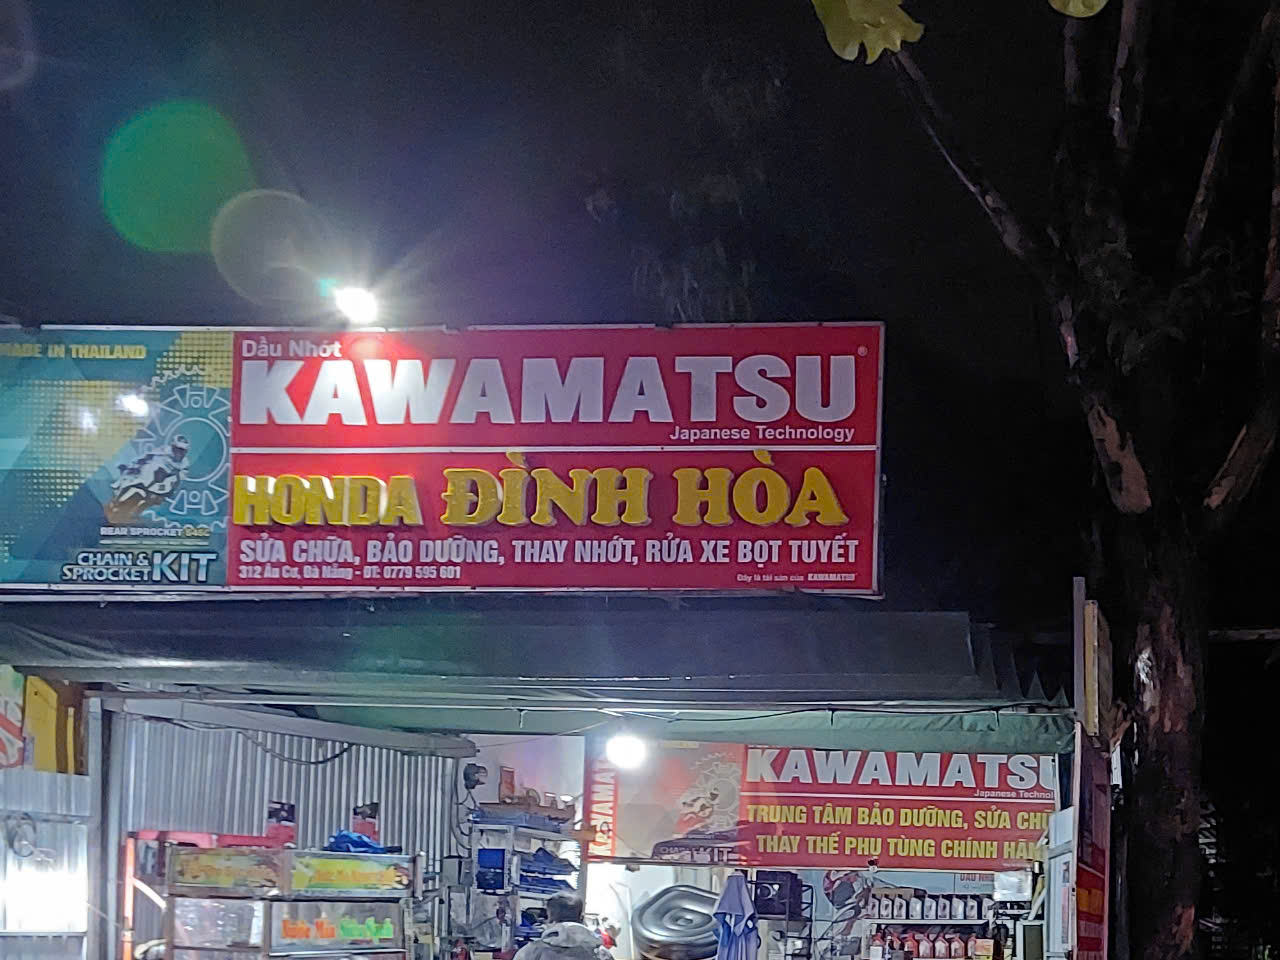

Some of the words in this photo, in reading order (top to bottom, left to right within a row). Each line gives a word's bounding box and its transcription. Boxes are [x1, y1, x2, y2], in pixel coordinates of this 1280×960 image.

[48, 344, 66, 358] IN
[71, 344, 147, 359] THAILAND
[242, 339, 282, 358] Dầu
[239, 354, 857, 426] KAWAMATSU
[670, 425, 750, 443] Japanese
[756, 425, 856, 443] Technology
[232, 474, 424, 528] HONDA
[440, 449, 654, 528] ĐÌNH
[672, 448, 850, 527] HÒA
[100, 526, 127, 536] REAR
[130, 526, 182, 536] SPROCKET
[239, 532, 286, 563] SỬA
[293, 535, 360, 565] CHỮA,
[366, 532, 413, 563] BẢO
[419, 534, 505, 566] DƯỠNG,
[512, 540, 569, 563] THAY
[574, 534, 639, 566] NHỚT,
[646, 531, 692, 563] RỬA
[700, 539, 730, 563] XE
[737, 539, 782, 568] BỌT
[788, 532, 860, 563] TUYẾT
[77, 552, 132, 566] CHAIN
[136, 552, 149, 565] &
[152, 552, 218, 582] KIT
[62, 565, 152, 581] SPROCKET
[239, 564, 261, 578] 312
[383, 565, 412, 579] 0779
[415, 565, 436, 579] 595
[439, 565, 461, 579] 601
[974, 789, 1016, 799] Japanese
[747, 803, 807, 824] TRUNG
[812, 802, 852, 825] TÂM
[857, 801, 895, 826] BẢO
[899, 804, 968, 830] DƯỠNG,
[974, 805, 1011, 829] SỬA
[756, 834, 800, 853] THAY
[806, 831, 842, 854] THẾ
[844, 836, 882, 859] PHỤ
[887, 834, 935, 857] TÙNG
[941, 836, 998, 859] CHÍNH
